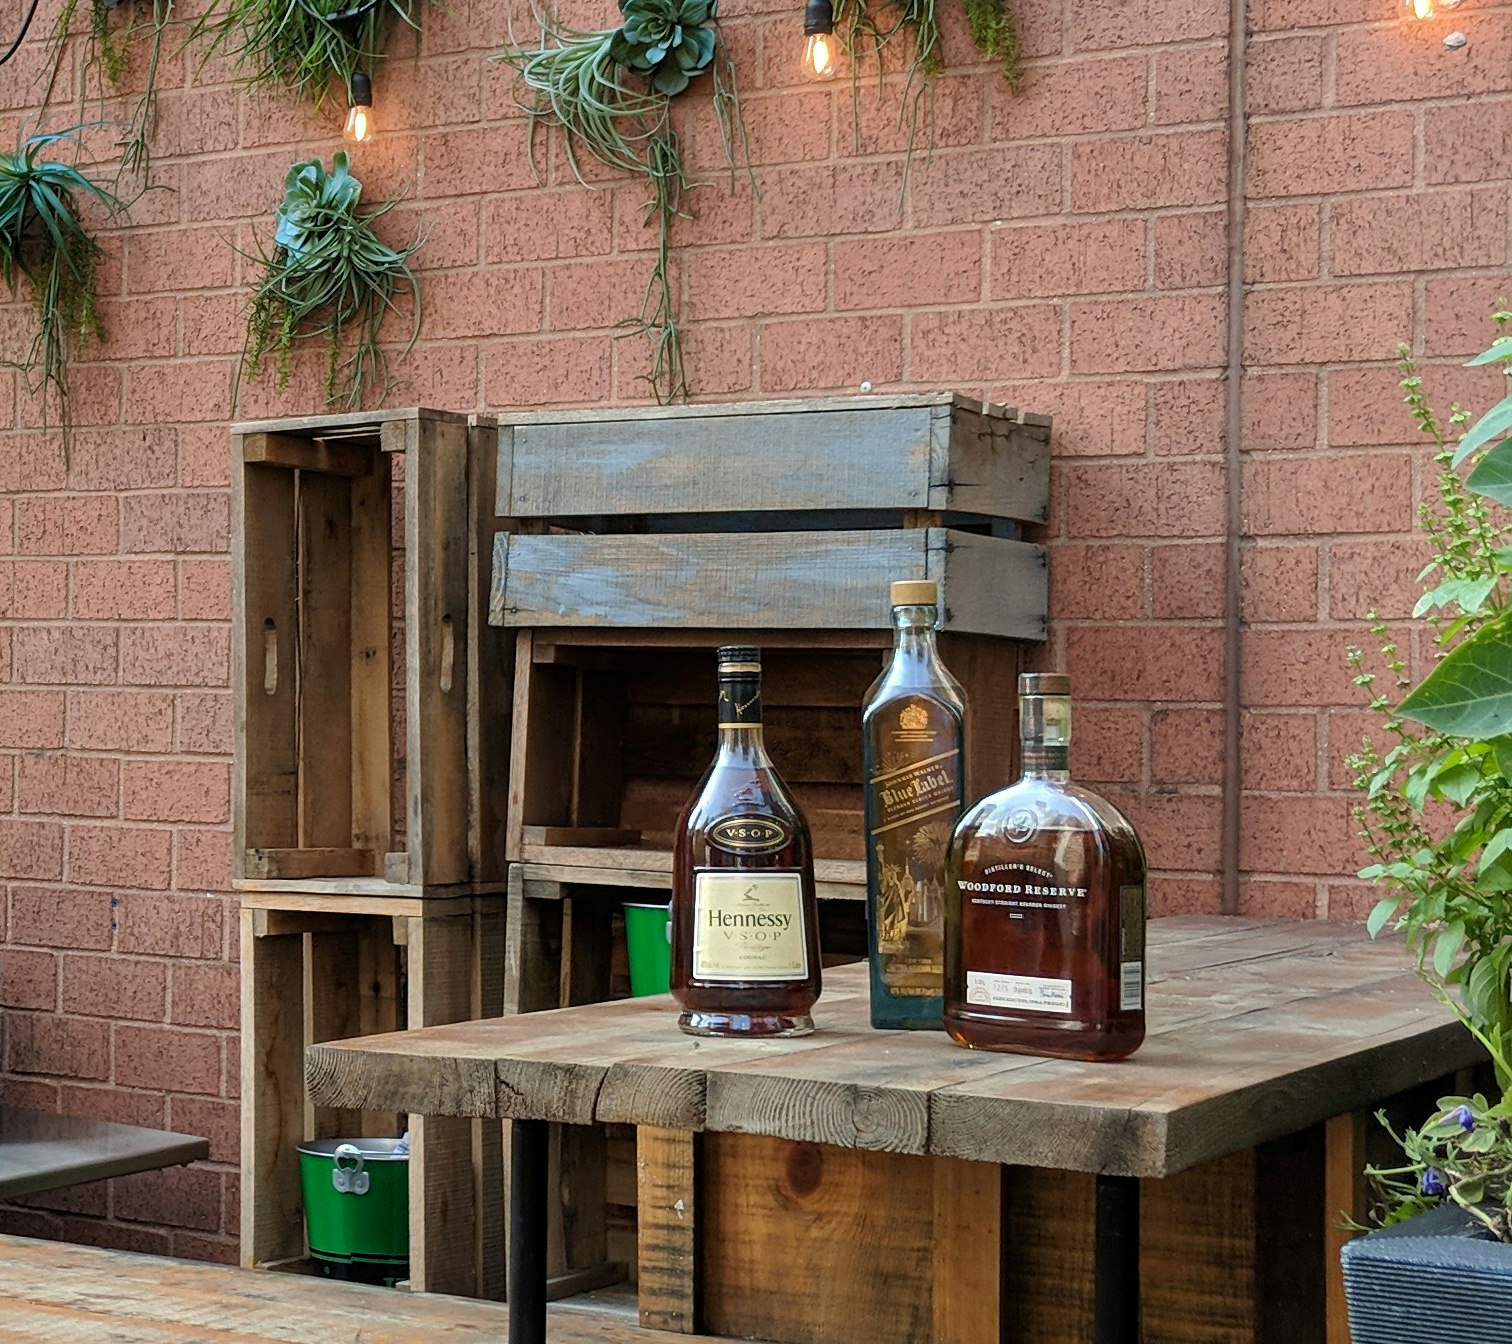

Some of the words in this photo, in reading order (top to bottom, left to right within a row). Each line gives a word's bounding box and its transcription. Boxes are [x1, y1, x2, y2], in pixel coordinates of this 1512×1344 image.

[879, 786, 915, 808] Blue
[910, 769, 950, 797] Label
[957, 880, 1022, 894] WOODFORD
[1025, 884, 1086, 897] RESERVE
[708, 909, 792, 931] Hennessy
